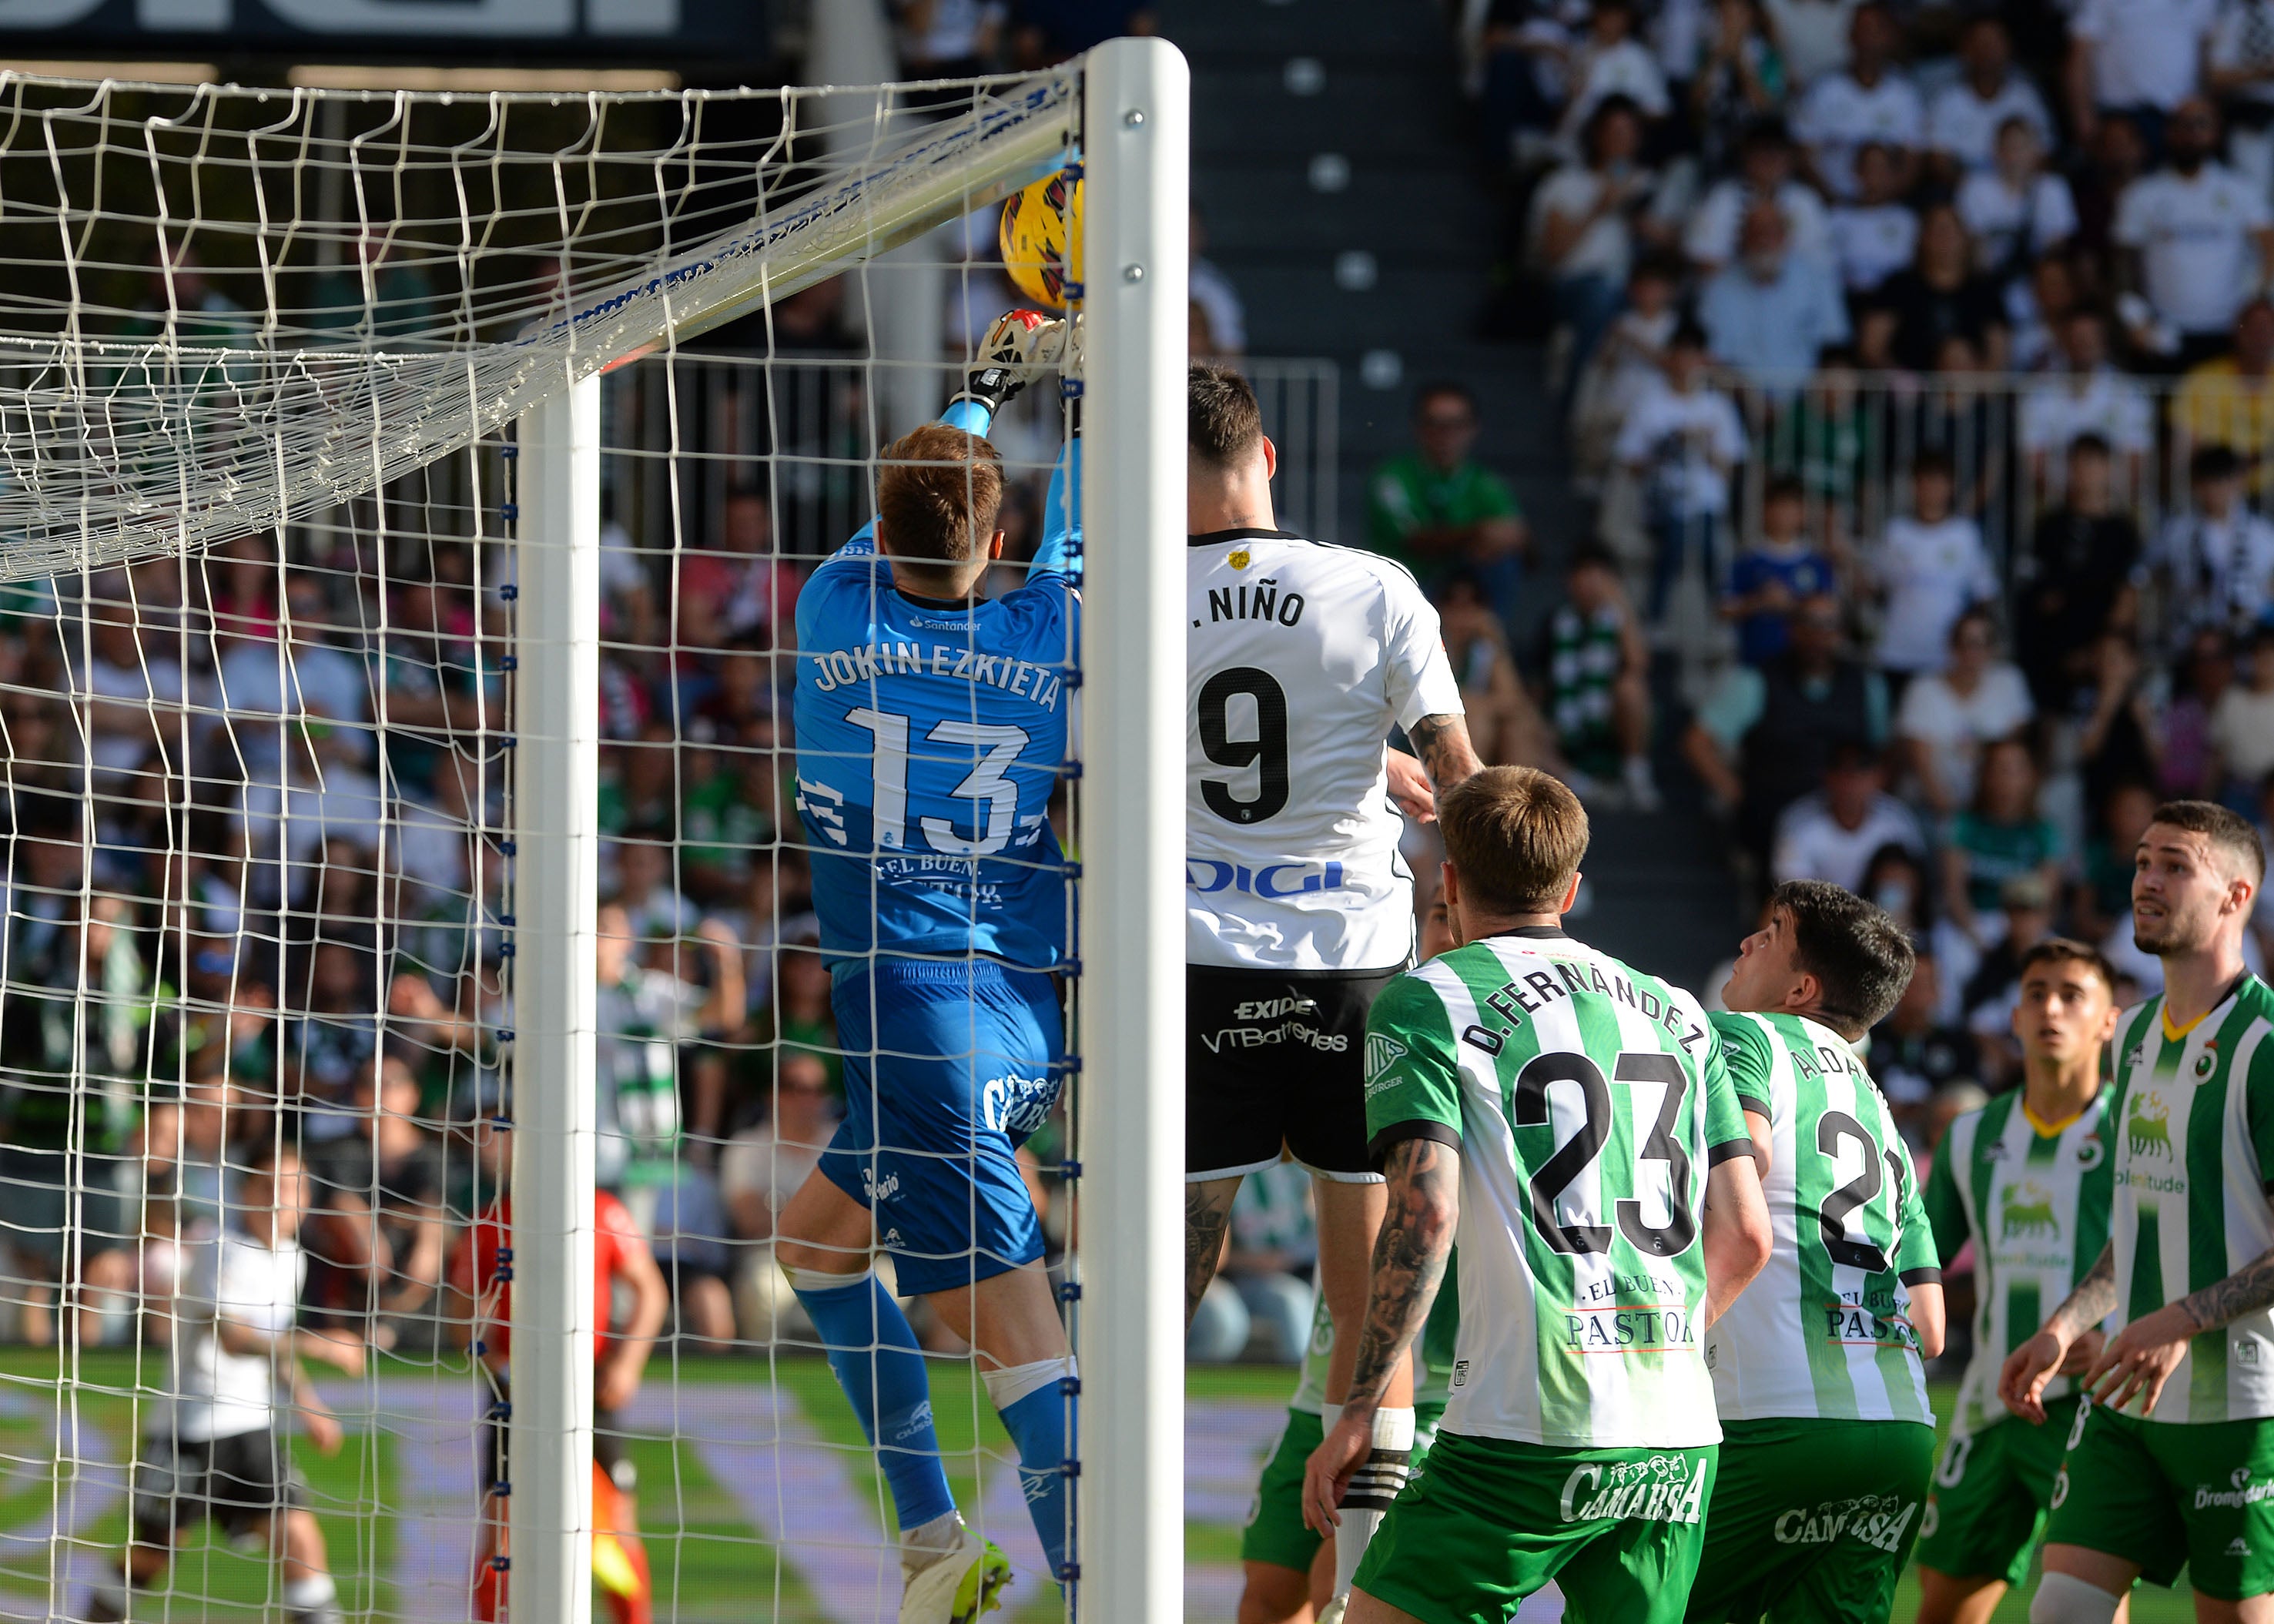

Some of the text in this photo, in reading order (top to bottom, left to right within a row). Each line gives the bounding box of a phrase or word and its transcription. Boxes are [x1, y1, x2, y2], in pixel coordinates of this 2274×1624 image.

[925, 620, 981, 631] Santander
[814, 641, 1061, 713] JOKIN EZKIETA
[844, 706, 1030, 855] 13
[1197, 665, 1290, 825] 9
[1234, 997, 1317, 1020] EXIDE
[1462, 963, 1705, 1058] D.FERNÁNDEZ
[1514, 1051, 1699, 1257] 23
[1560, 1458, 1707, 1525] CAMARSA
